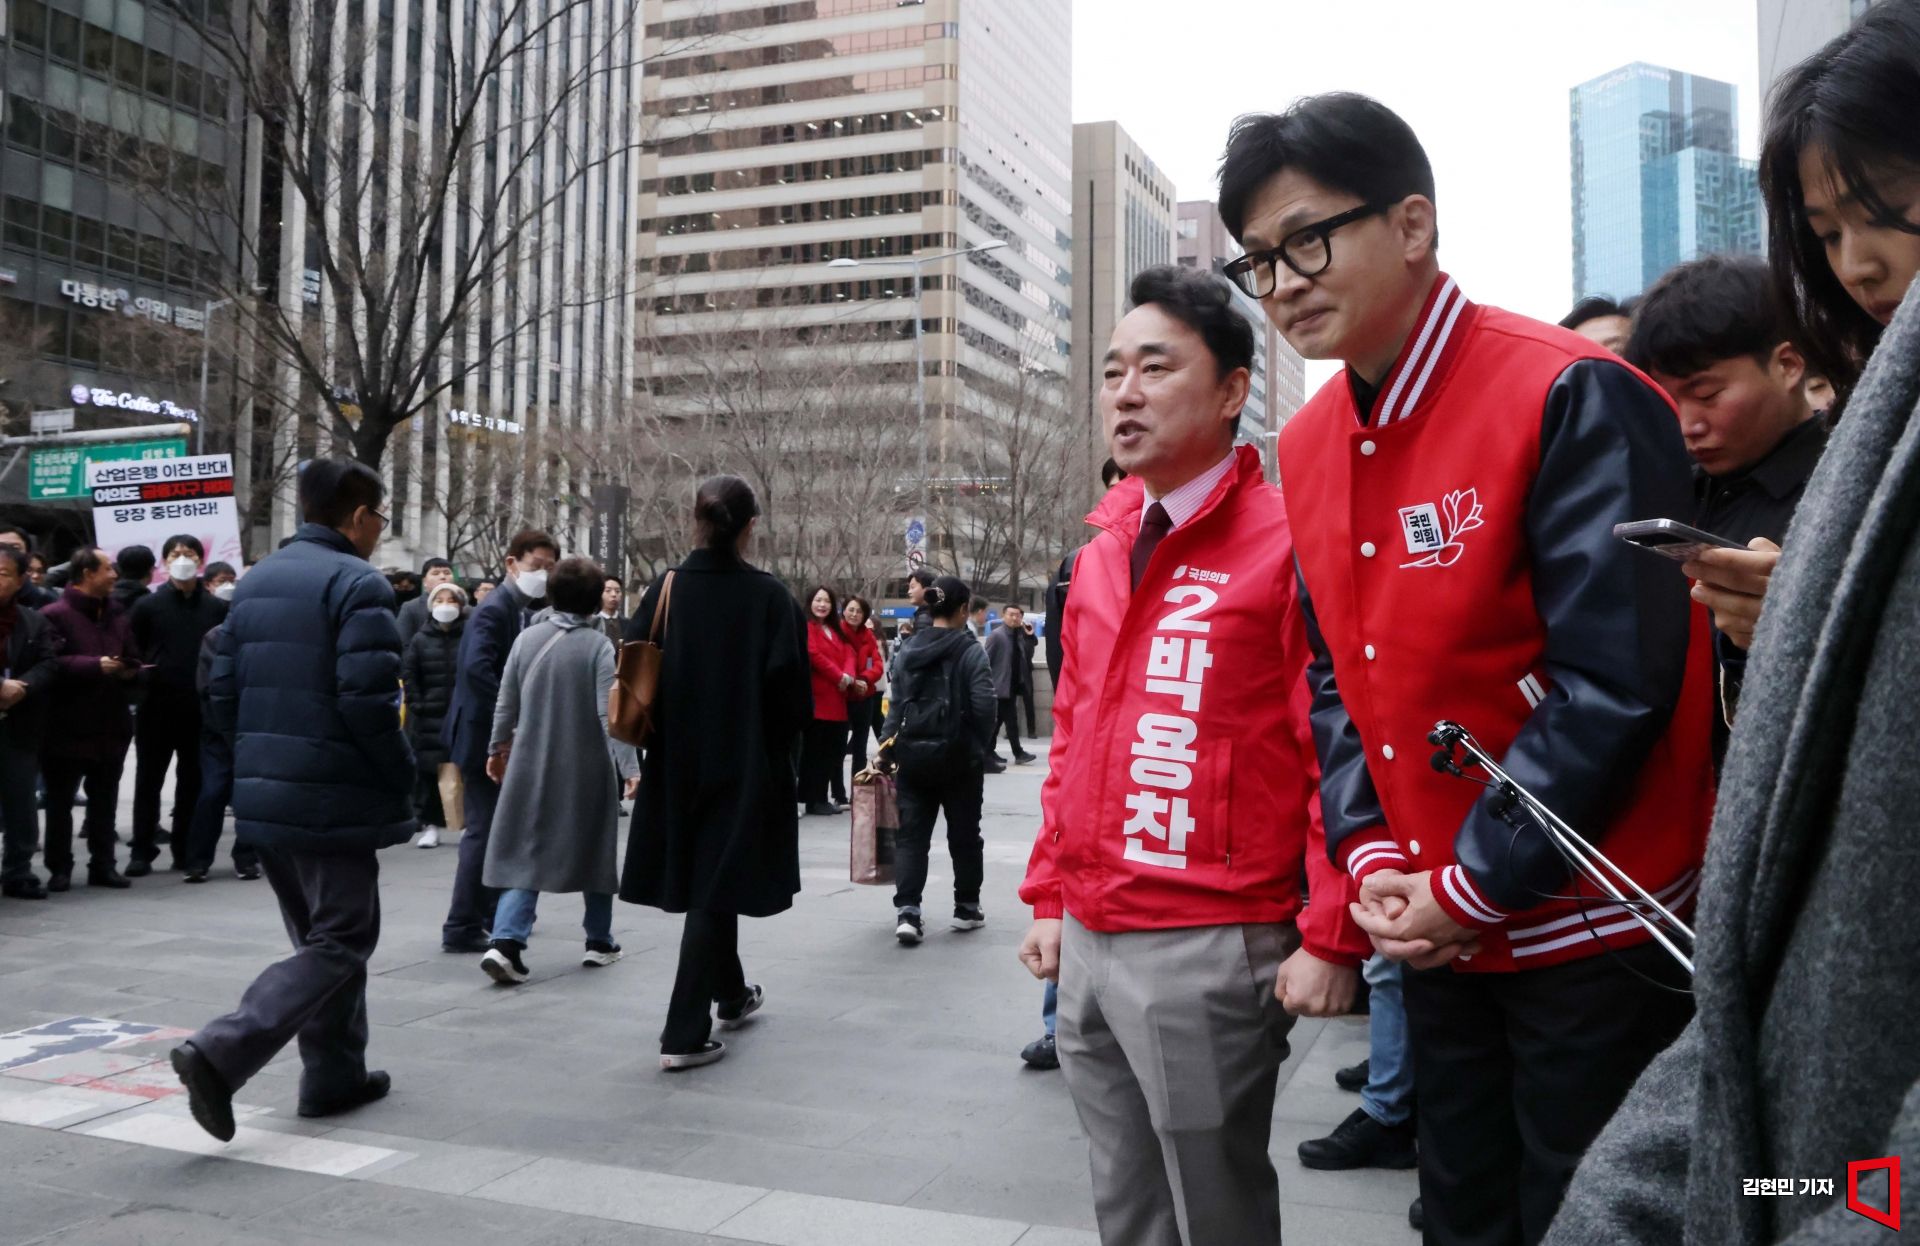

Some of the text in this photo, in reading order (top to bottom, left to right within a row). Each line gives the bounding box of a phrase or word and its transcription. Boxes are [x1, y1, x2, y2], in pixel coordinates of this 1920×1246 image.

[90, 388, 118, 406] The
[117, 392, 160, 413] Coffee
[95, 460, 228, 483] 산업은행 이전 반대
[94, 486, 141, 503] 여의도
[142, 481, 201, 500] 금융지구
[114, 502, 219, 523] 당장 중단하라!
[1409, 512, 1432, 528] 국민
[1413, 527, 1436, 543] 의힘
[1188, 567, 1231, 585] 국민의힘
[1123, 585, 1218, 870] 2 박용찬
